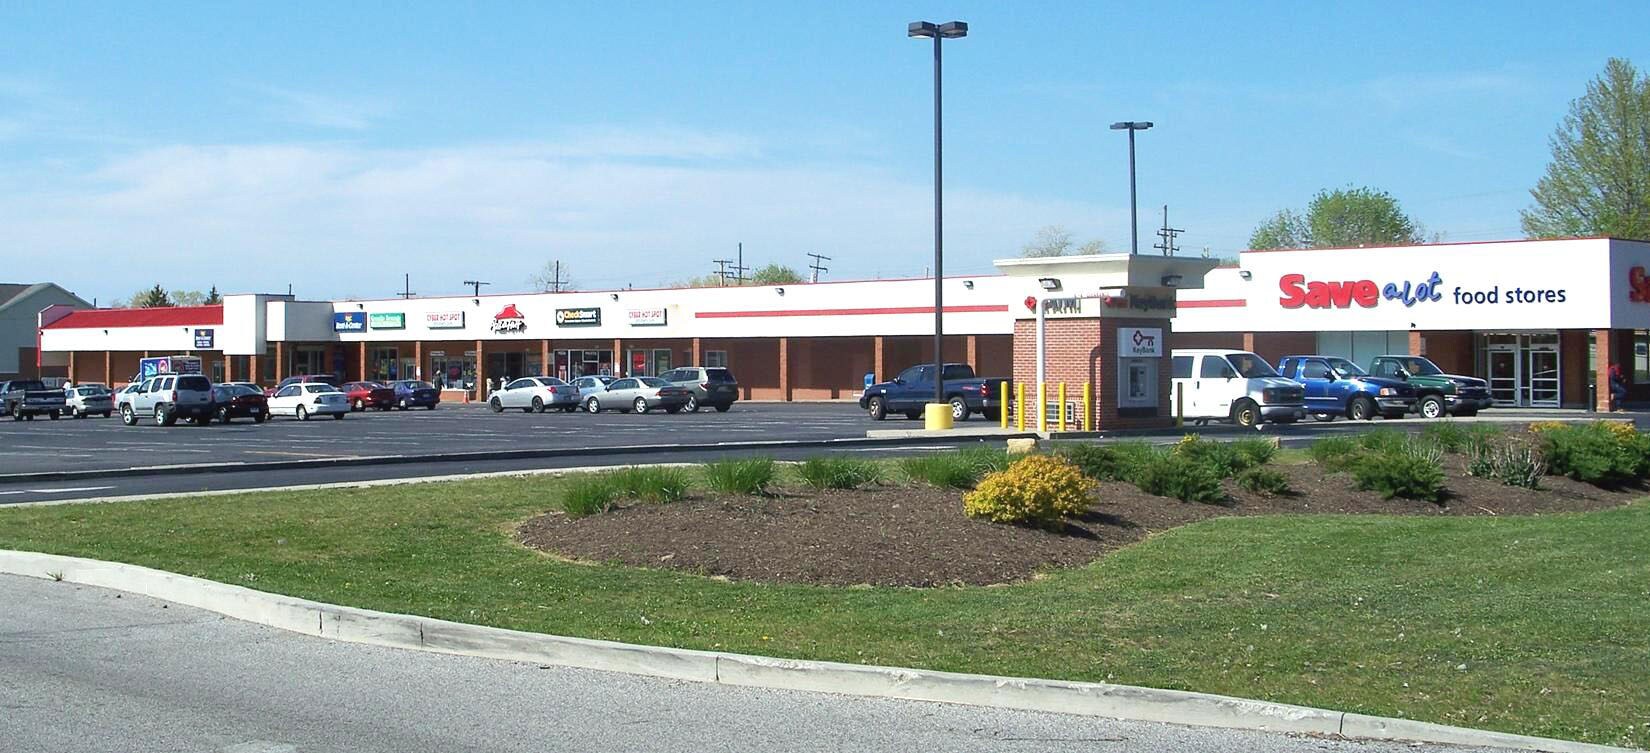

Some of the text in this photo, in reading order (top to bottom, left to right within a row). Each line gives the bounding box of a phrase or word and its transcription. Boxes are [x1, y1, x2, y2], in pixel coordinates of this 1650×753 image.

[1279, 273, 1380, 309] Save
[1453, 286, 1499, 305] food
[1505, 287, 1567, 304] stores
